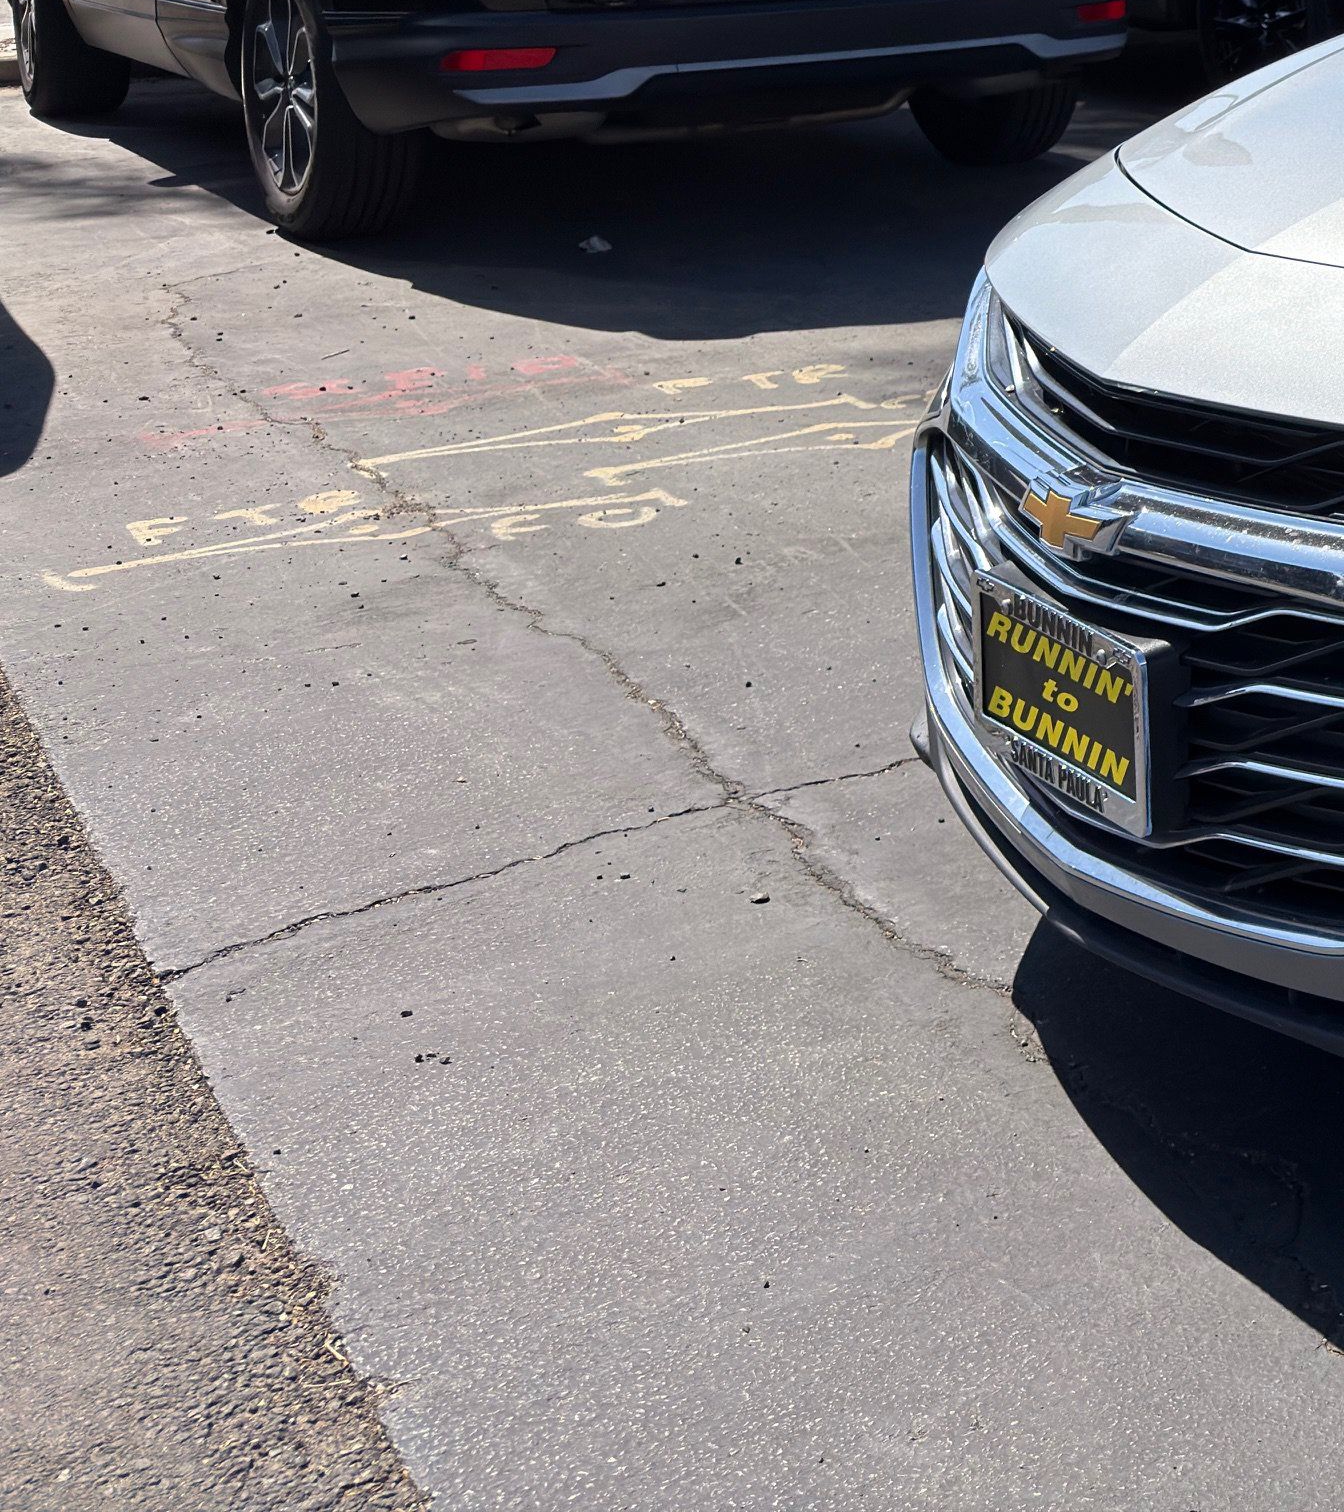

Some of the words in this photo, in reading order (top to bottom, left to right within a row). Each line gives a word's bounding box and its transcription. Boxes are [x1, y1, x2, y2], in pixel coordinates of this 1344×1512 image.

[1013, 592, 1094, 657] BUNNIN
[1041, 679, 1080, 713] to
[987, 685, 1131, 786] BUNNIN
